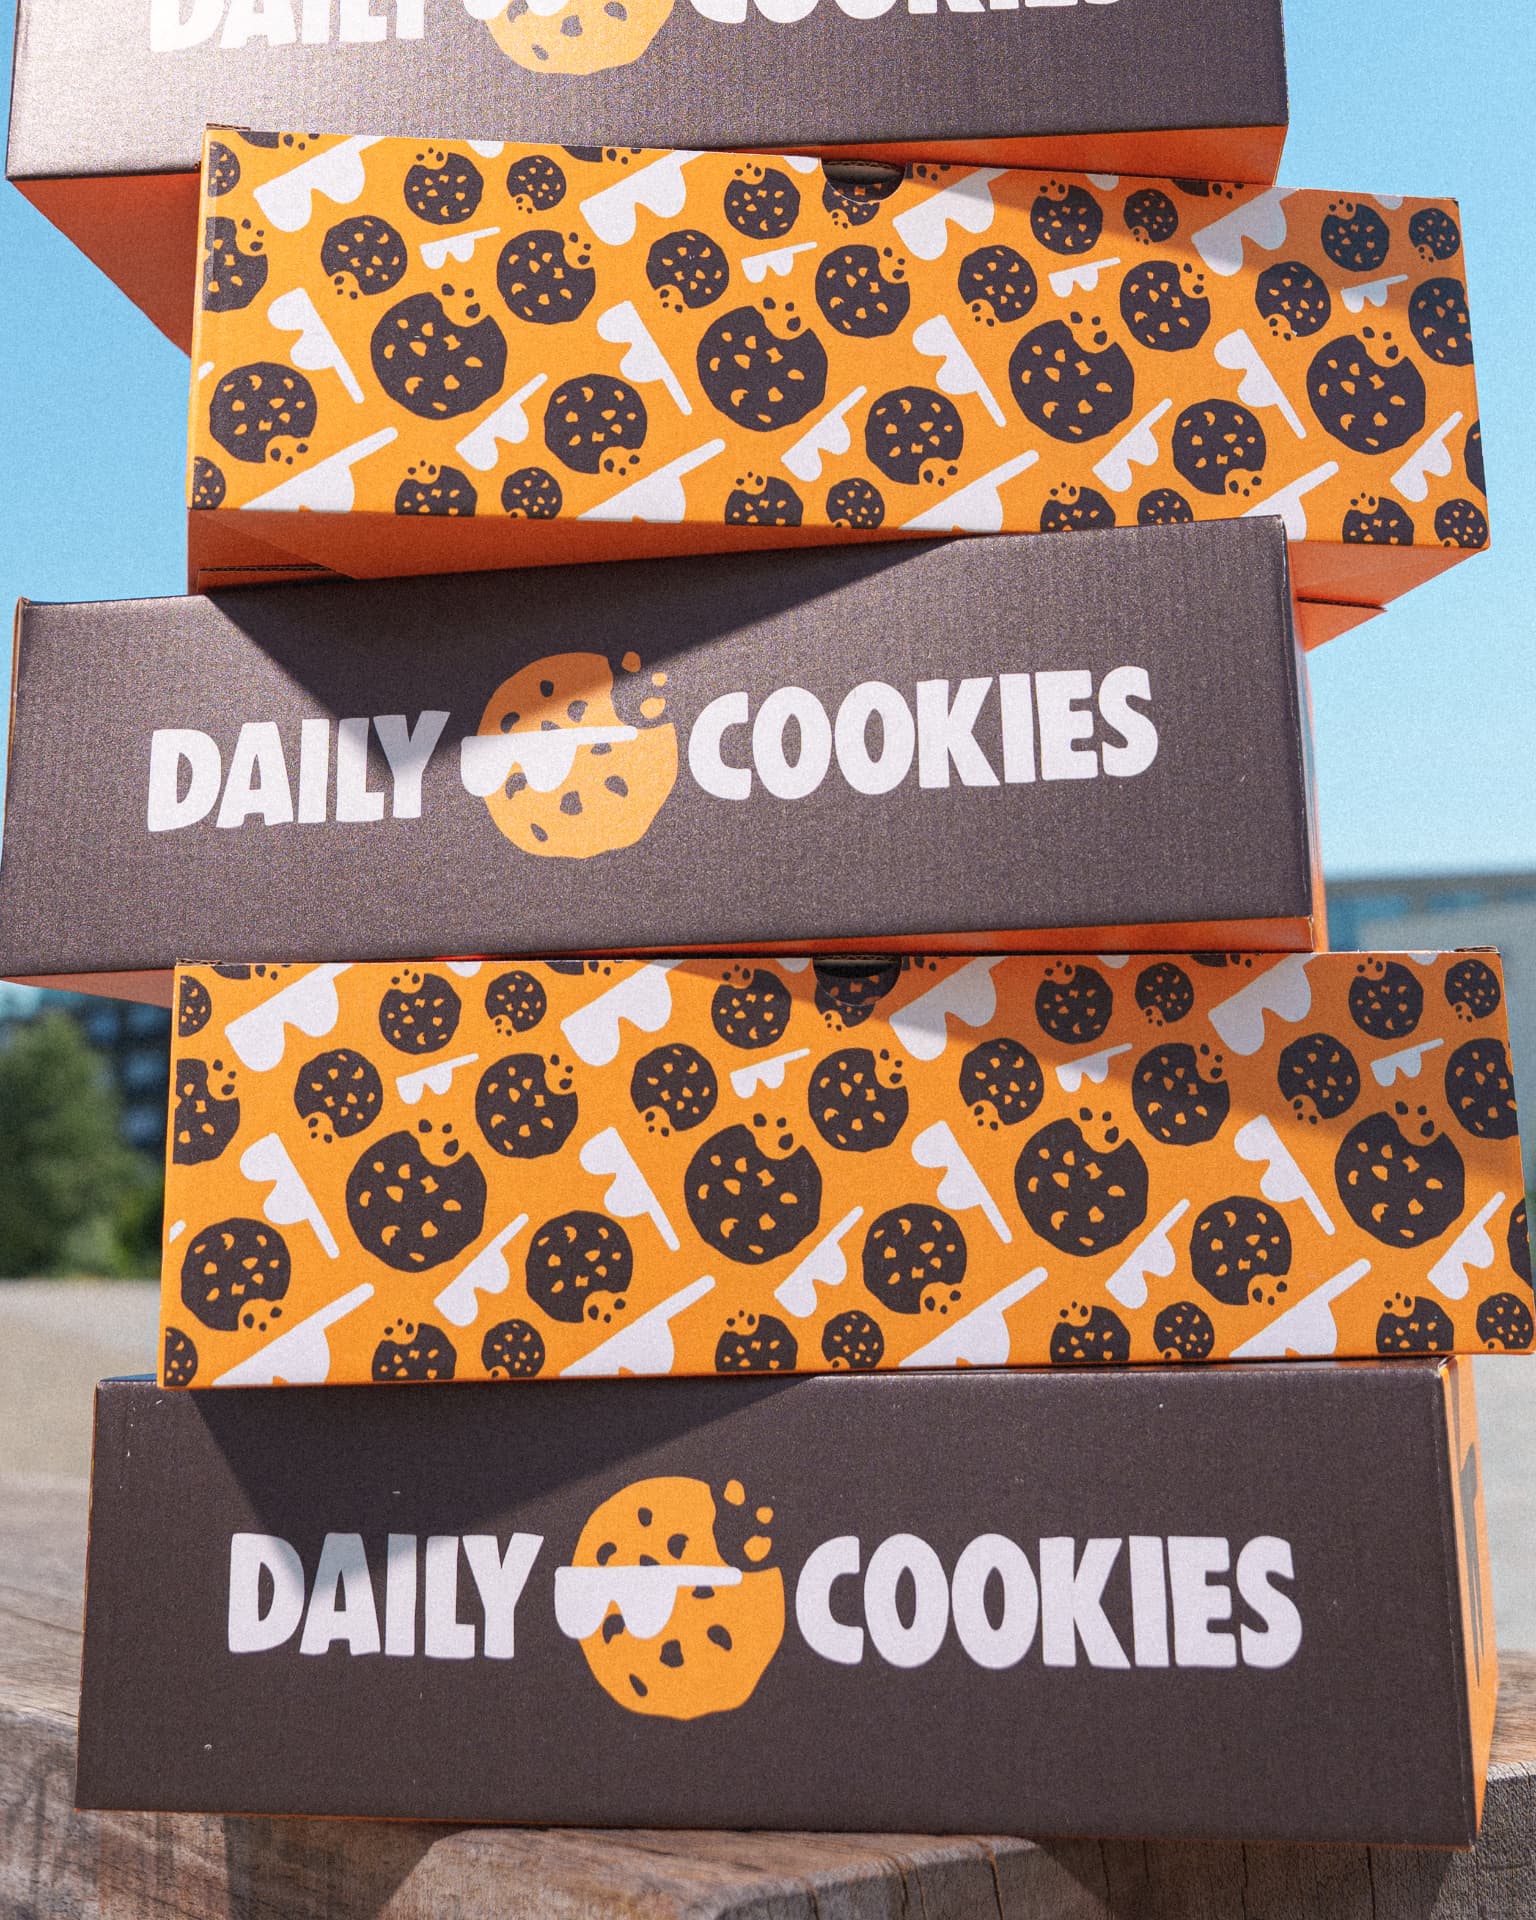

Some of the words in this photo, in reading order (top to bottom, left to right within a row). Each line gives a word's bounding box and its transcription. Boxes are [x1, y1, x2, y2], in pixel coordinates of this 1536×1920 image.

[147, 710, 451, 832] DAILY
[688, 666, 1159, 800] COOKIES
[227, 1532, 545, 1660] DAILY
[795, 1532, 1303, 1670] COOKIES
